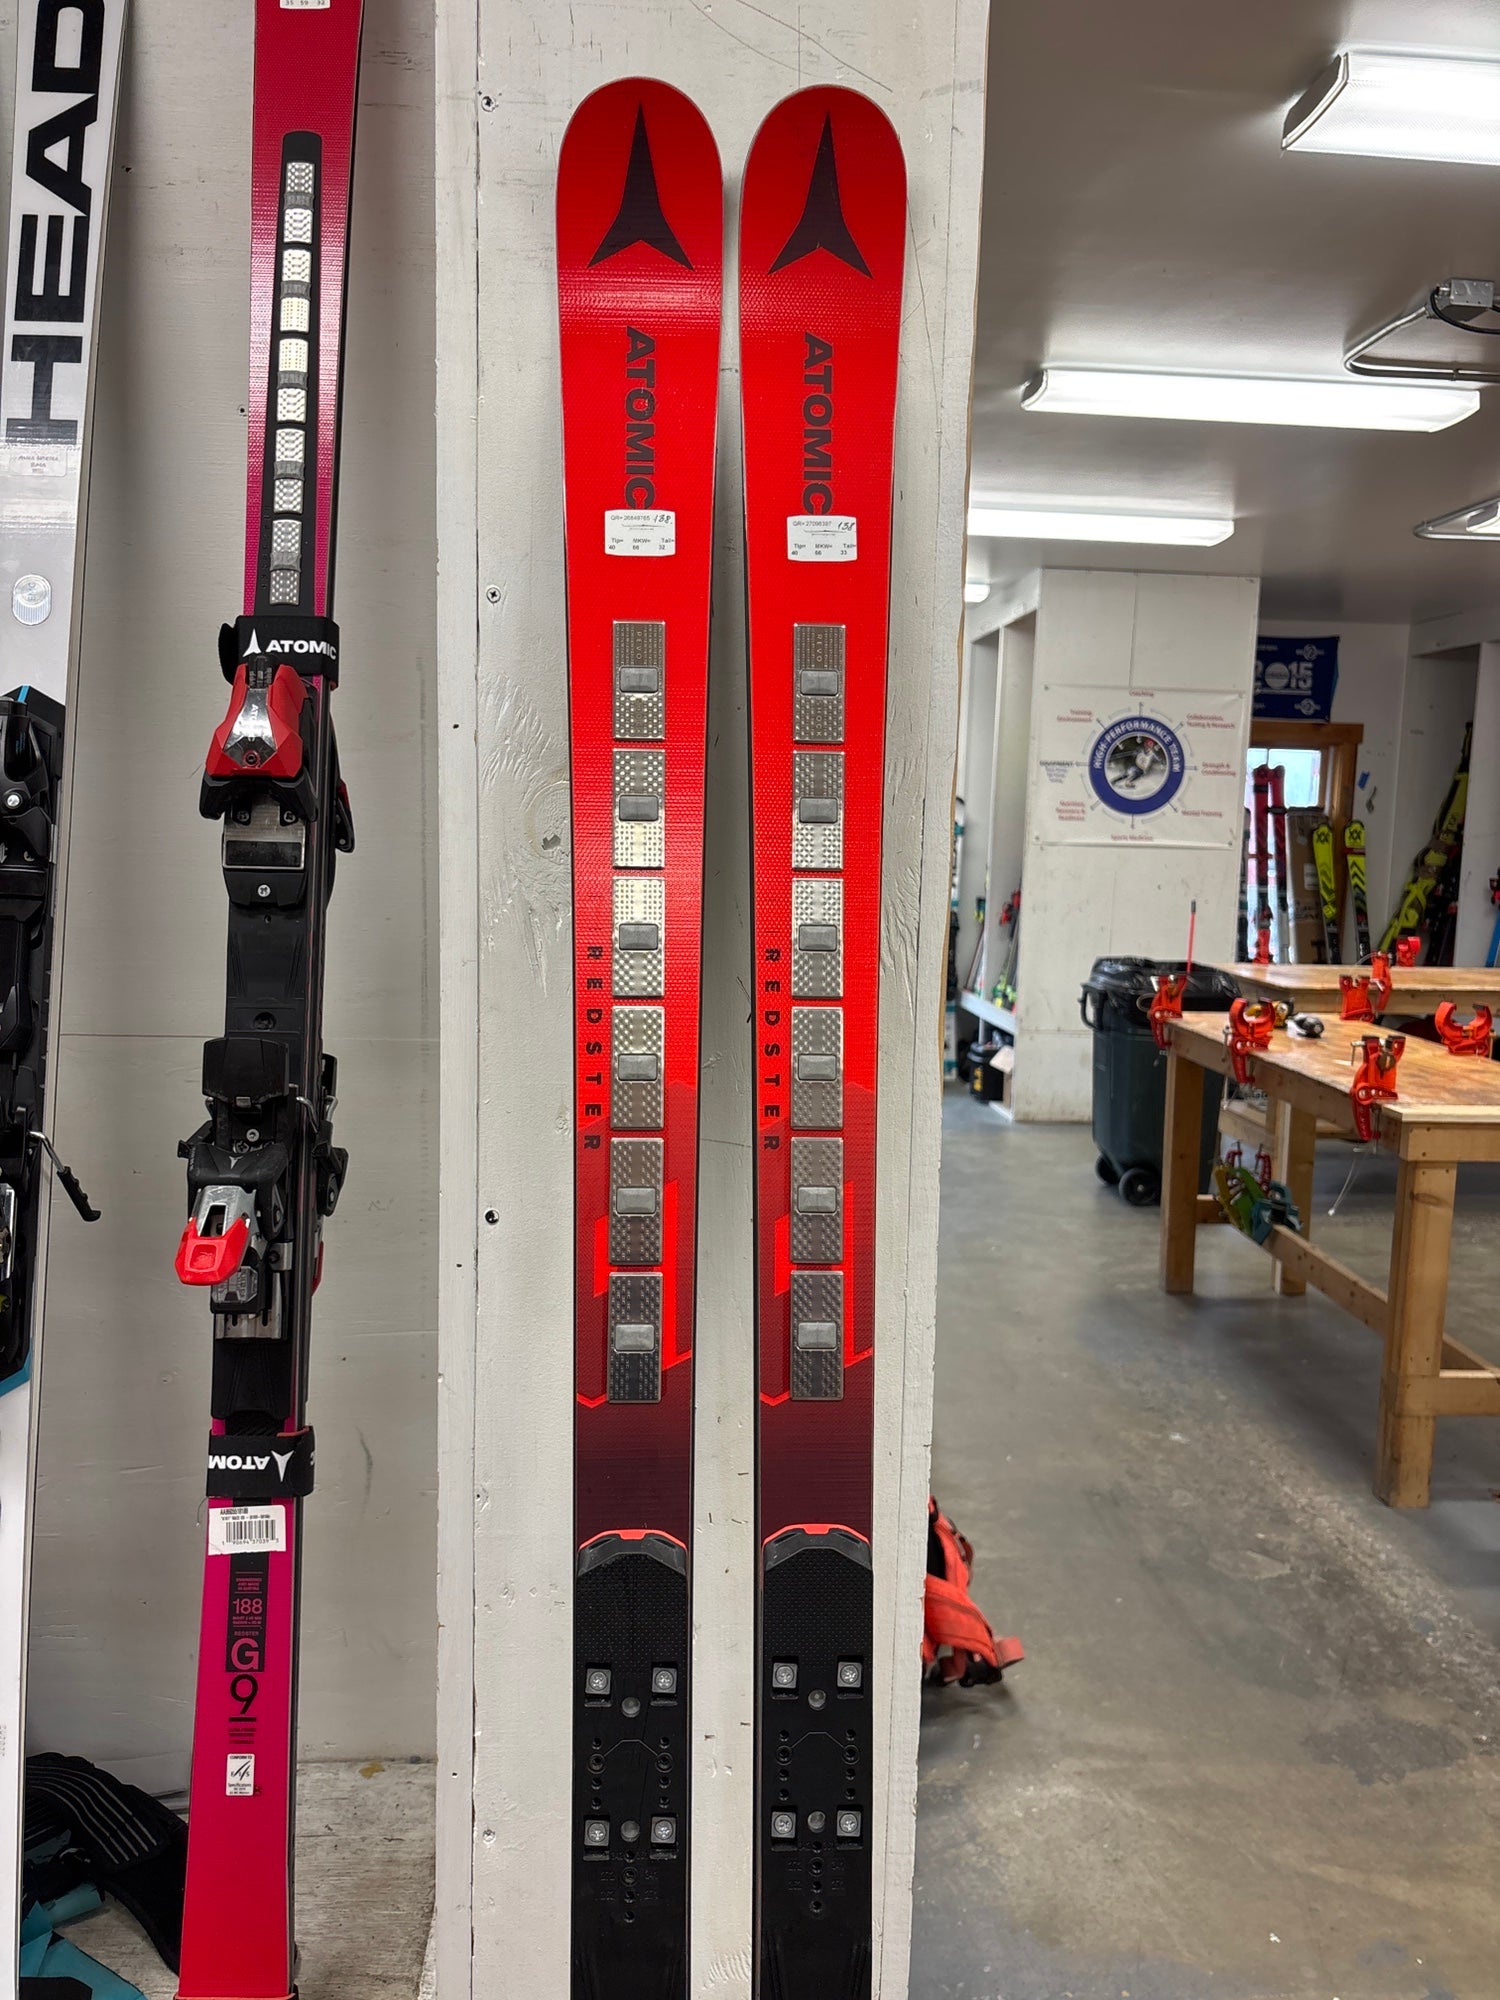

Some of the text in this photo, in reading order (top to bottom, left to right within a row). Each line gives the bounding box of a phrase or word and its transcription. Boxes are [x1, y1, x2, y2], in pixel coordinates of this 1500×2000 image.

[5, 0, 105, 446] HEAD
[624, 325, 656, 510] ATOMIC
[802, 331, 834, 515] ATOMIC
[265, 639, 337, 660] ATOMIC
[583, 945, 604, 1150] REDSTER
[764, 947, 781, 1151] REDSTER
[229, 1674, 259, 1715] 9
[230, 1637, 259, 1670] G
[232, 1598, 263, 1615] 188
